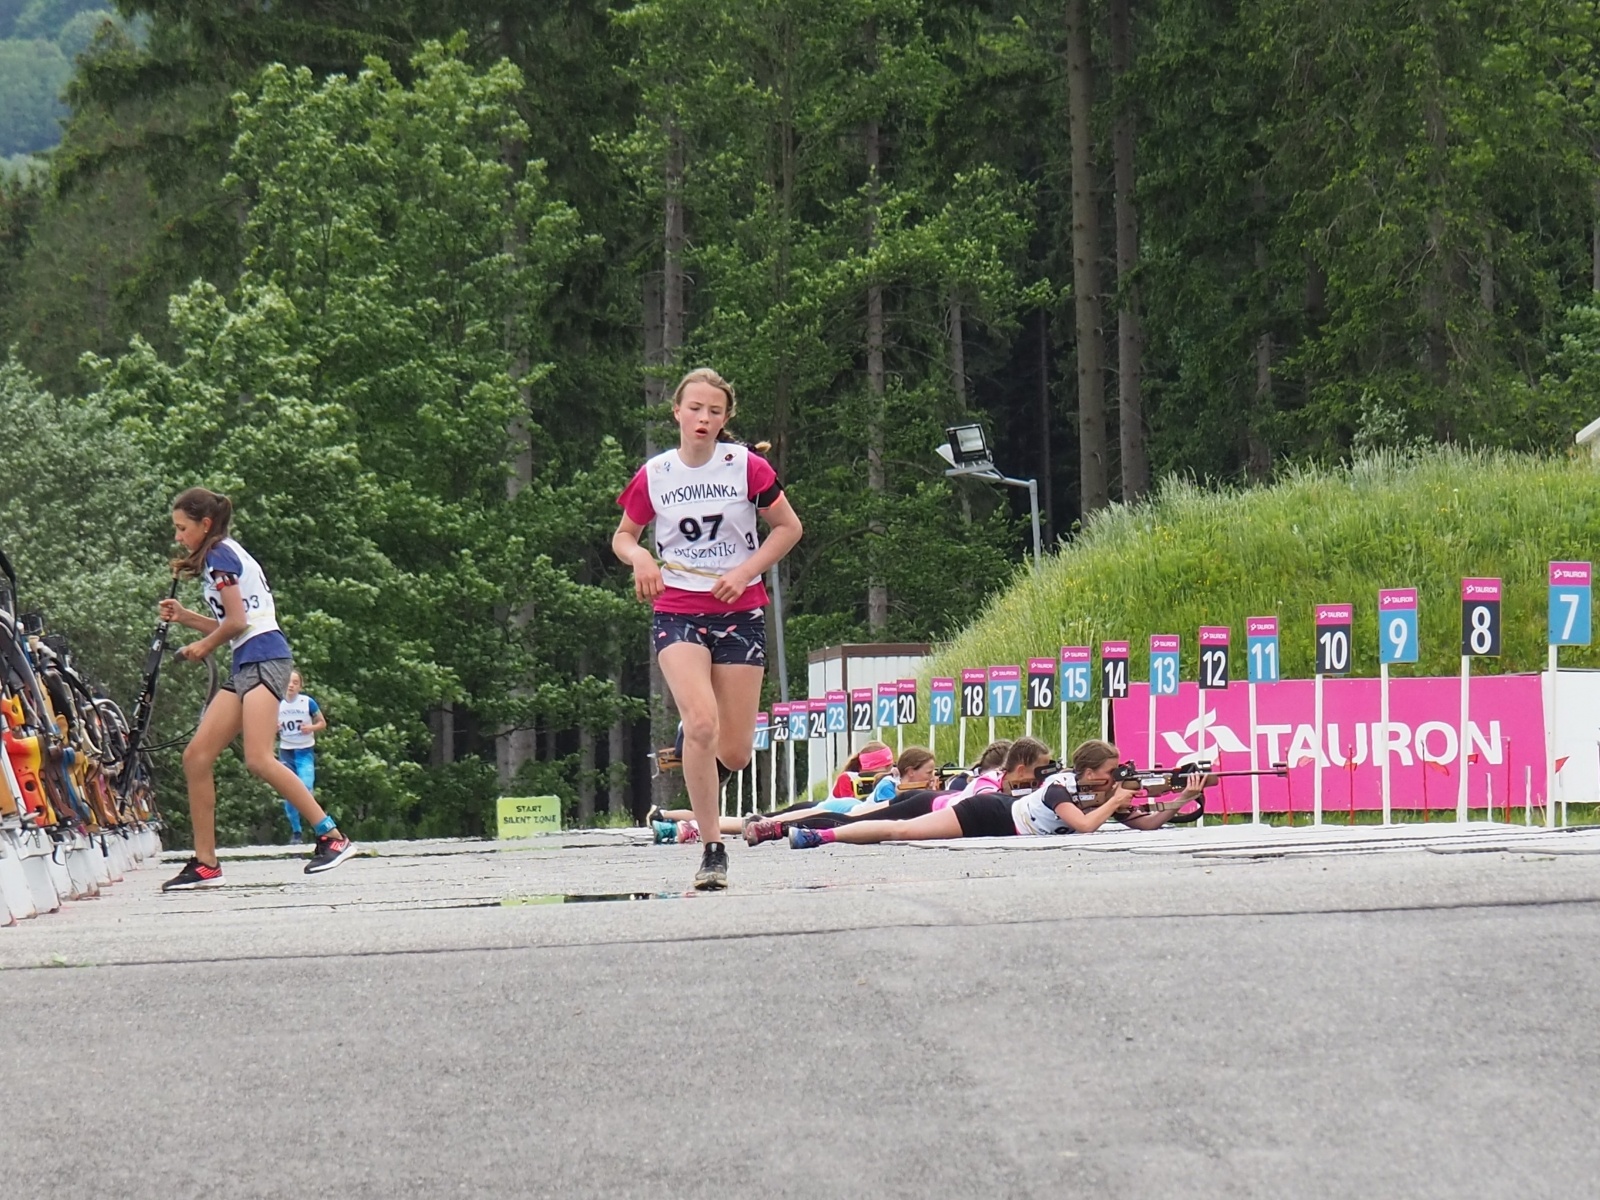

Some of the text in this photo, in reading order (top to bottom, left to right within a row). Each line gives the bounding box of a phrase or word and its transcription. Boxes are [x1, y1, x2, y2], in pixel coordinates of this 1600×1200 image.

[661, 483, 737, 505] WYSOWIANKA
[678, 513, 725, 542] 97
[1562, 570, 1587, 579] TAURON
[1391, 596, 1413, 604] TAURON
[1474, 585, 1498, 594] TAURON
[1470, 605, 1491, 654] 8
[1559, 594, 1580, 640] 7
[1319, 631, 1348, 670] 10
[1389, 617, 1408, 659] 9
[1153, 657, 1175, 693] 13
[1202, 650, 1226, 686] 12
[1251, 642, 1276, 679] 11
[1030, 678, 1052, 708] 16
[1064, 667, 1087, 698] 15
[1104, 661, 1126, 697] 14
[879, 698, 897, 726] 21
[898, 694, 916, 724] 20
[933, 696, 952, 722] 19
[964, 685, 983, 716] 18
[992, 685, 1017, 713] 17
[791, 715, 806, 740] 25
[810, 712, 827, 738] 24
[829, 706, 845, 731] 23
[853, 702, 871, 730] 22
[1256, 719, 1504, 768] TAURON
[503, 816, 532, 824] SILENT
[516, 805, 542, 813] START
